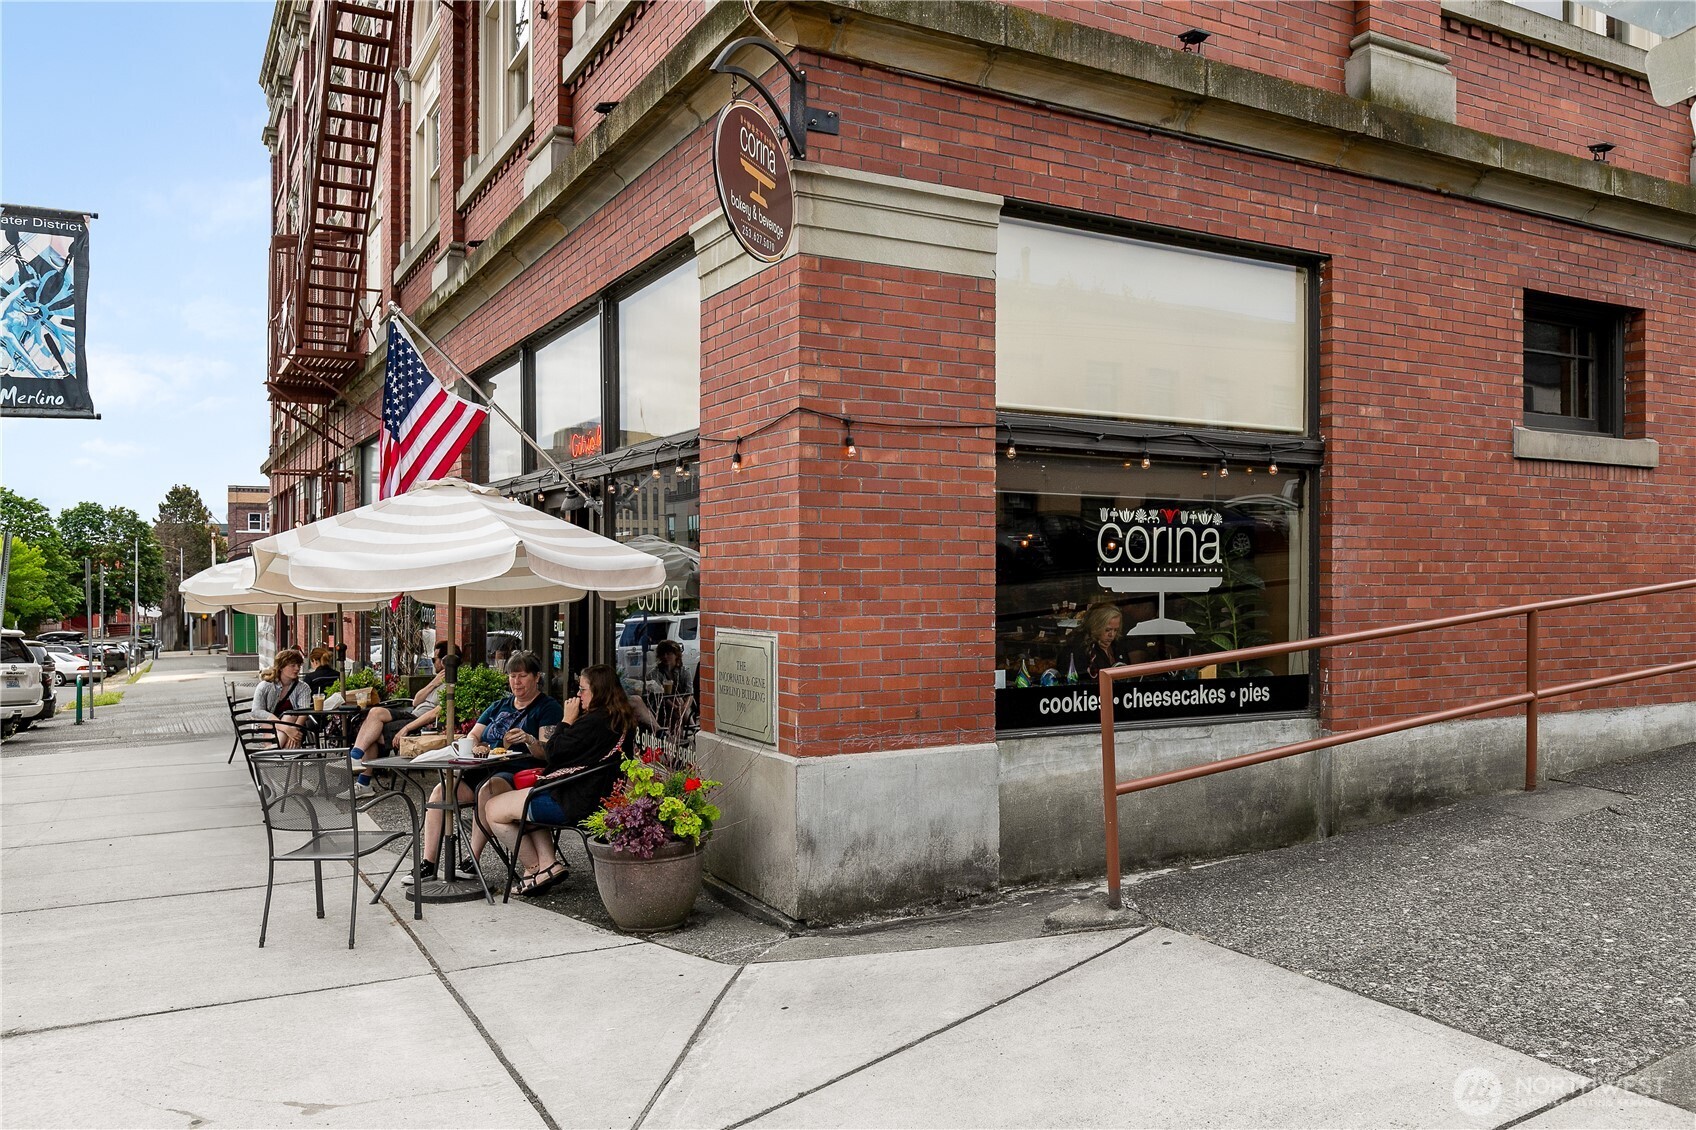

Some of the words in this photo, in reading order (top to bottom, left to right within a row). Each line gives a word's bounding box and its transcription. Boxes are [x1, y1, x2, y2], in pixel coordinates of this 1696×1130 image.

[740, 127, 777, 175] corina
[32, 217, 83, 232] District
[730, 189, 752, 221] bakery
[752, 204, 758, 222] &
[758, 208, 784, 240] beverage
[0, 385, 65, 407] Merlino
[1097, 522, 1223, 565] corina
[736, 660, 747, 671] THE
[745, 676, 751, 686] &
[751, 676, 766, 689] GENE
[741, 689, 766, 703] BUILDING
[1122, 684, 1226, 709] cheesecakes
[1239, 682, 1270, 707] pies
[635, 726, 641, 744] &
[641, 729, 662, 751] gluten
